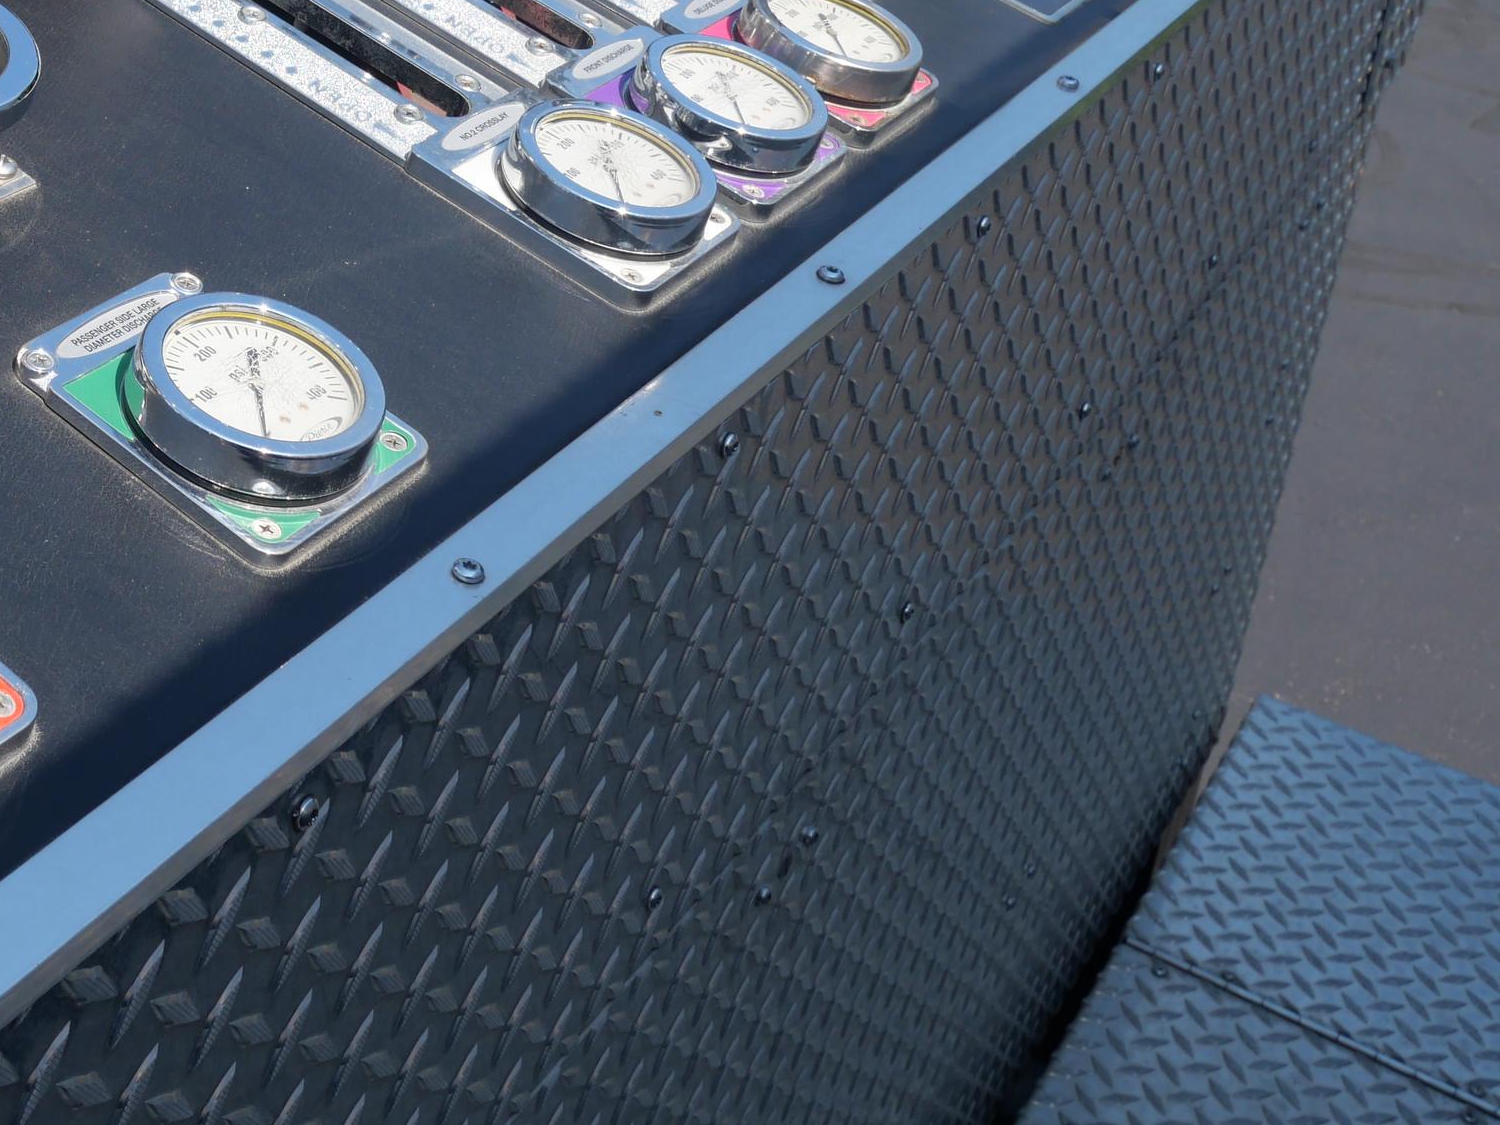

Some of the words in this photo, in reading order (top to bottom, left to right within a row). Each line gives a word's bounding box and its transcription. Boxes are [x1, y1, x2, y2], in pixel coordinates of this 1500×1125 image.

[583, 58, 603, 73] FRONT
[602, 43, 634, 63] DISCHARGE
[460, 129, 477, 141] NO.2
[475, 112, 508, 133] CROSSLAY
[566, 167, 581, 179] 00
[71, 320, 117, 347] PASSENGER
[115, 309, 135, 325] SIDE
[133, 298, 160, 316] LARGE
[83, 328, 126, 353] DIAMETER
[193, 345, 217, 363] 200
[195, 386, 218, 403] 100
